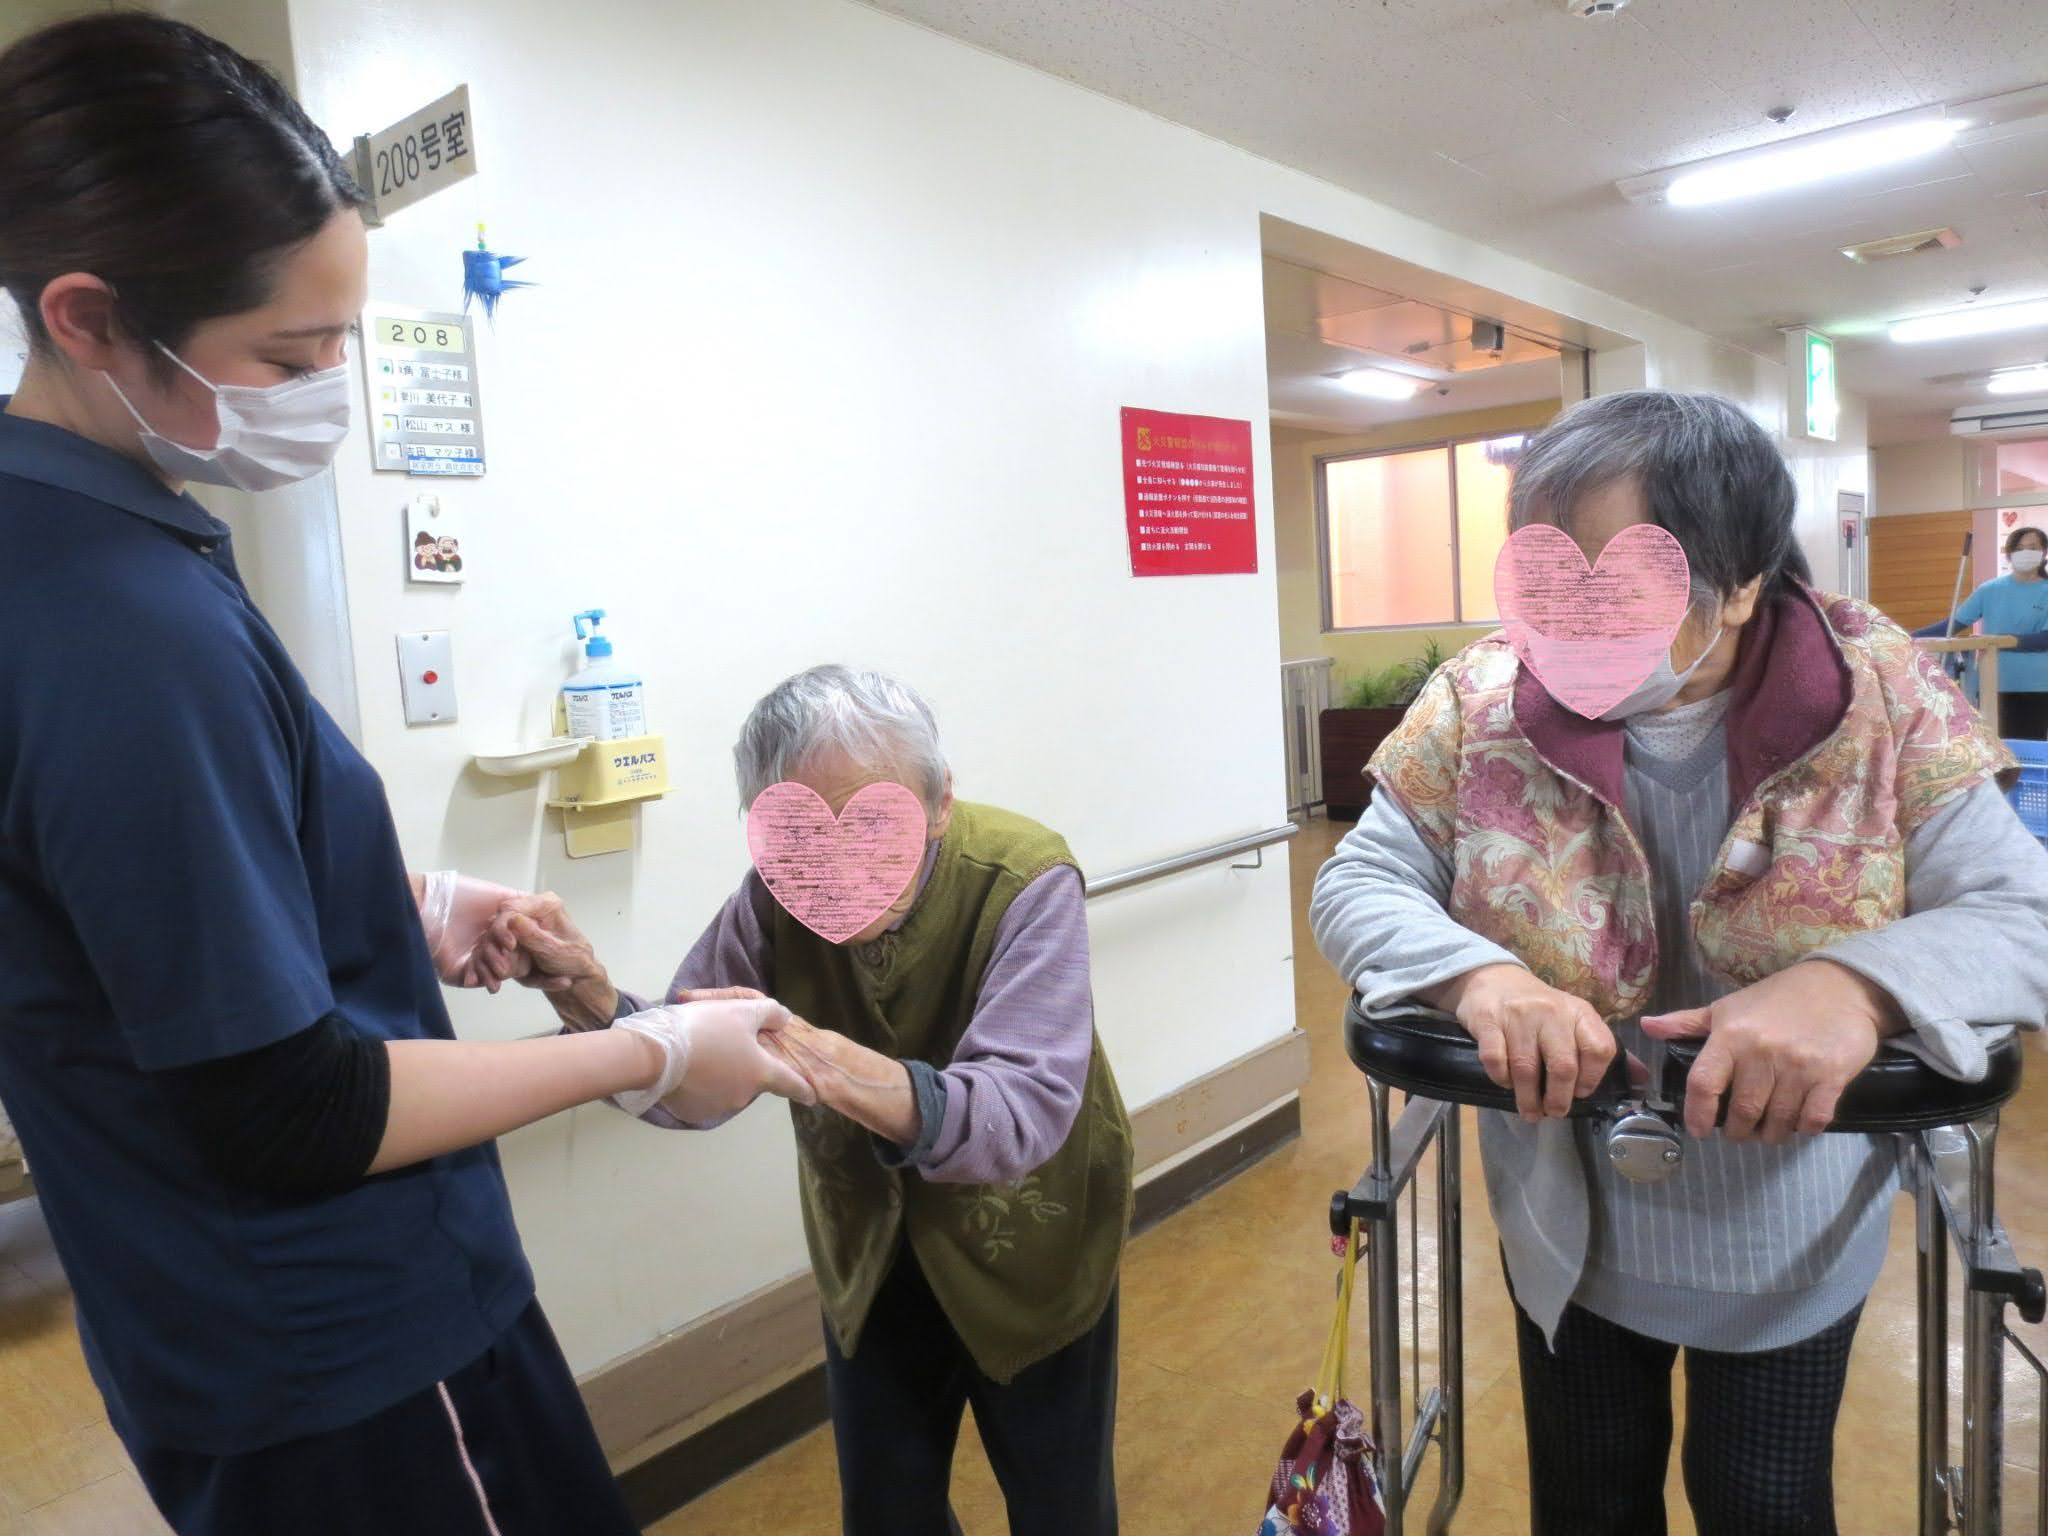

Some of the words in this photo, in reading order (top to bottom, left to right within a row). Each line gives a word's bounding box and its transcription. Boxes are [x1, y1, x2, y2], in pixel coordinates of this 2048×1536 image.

[376, 110, 469, 197] 208号室
[391, 324, 449, 346] 208
[405, 419, 428, 431] 松山
